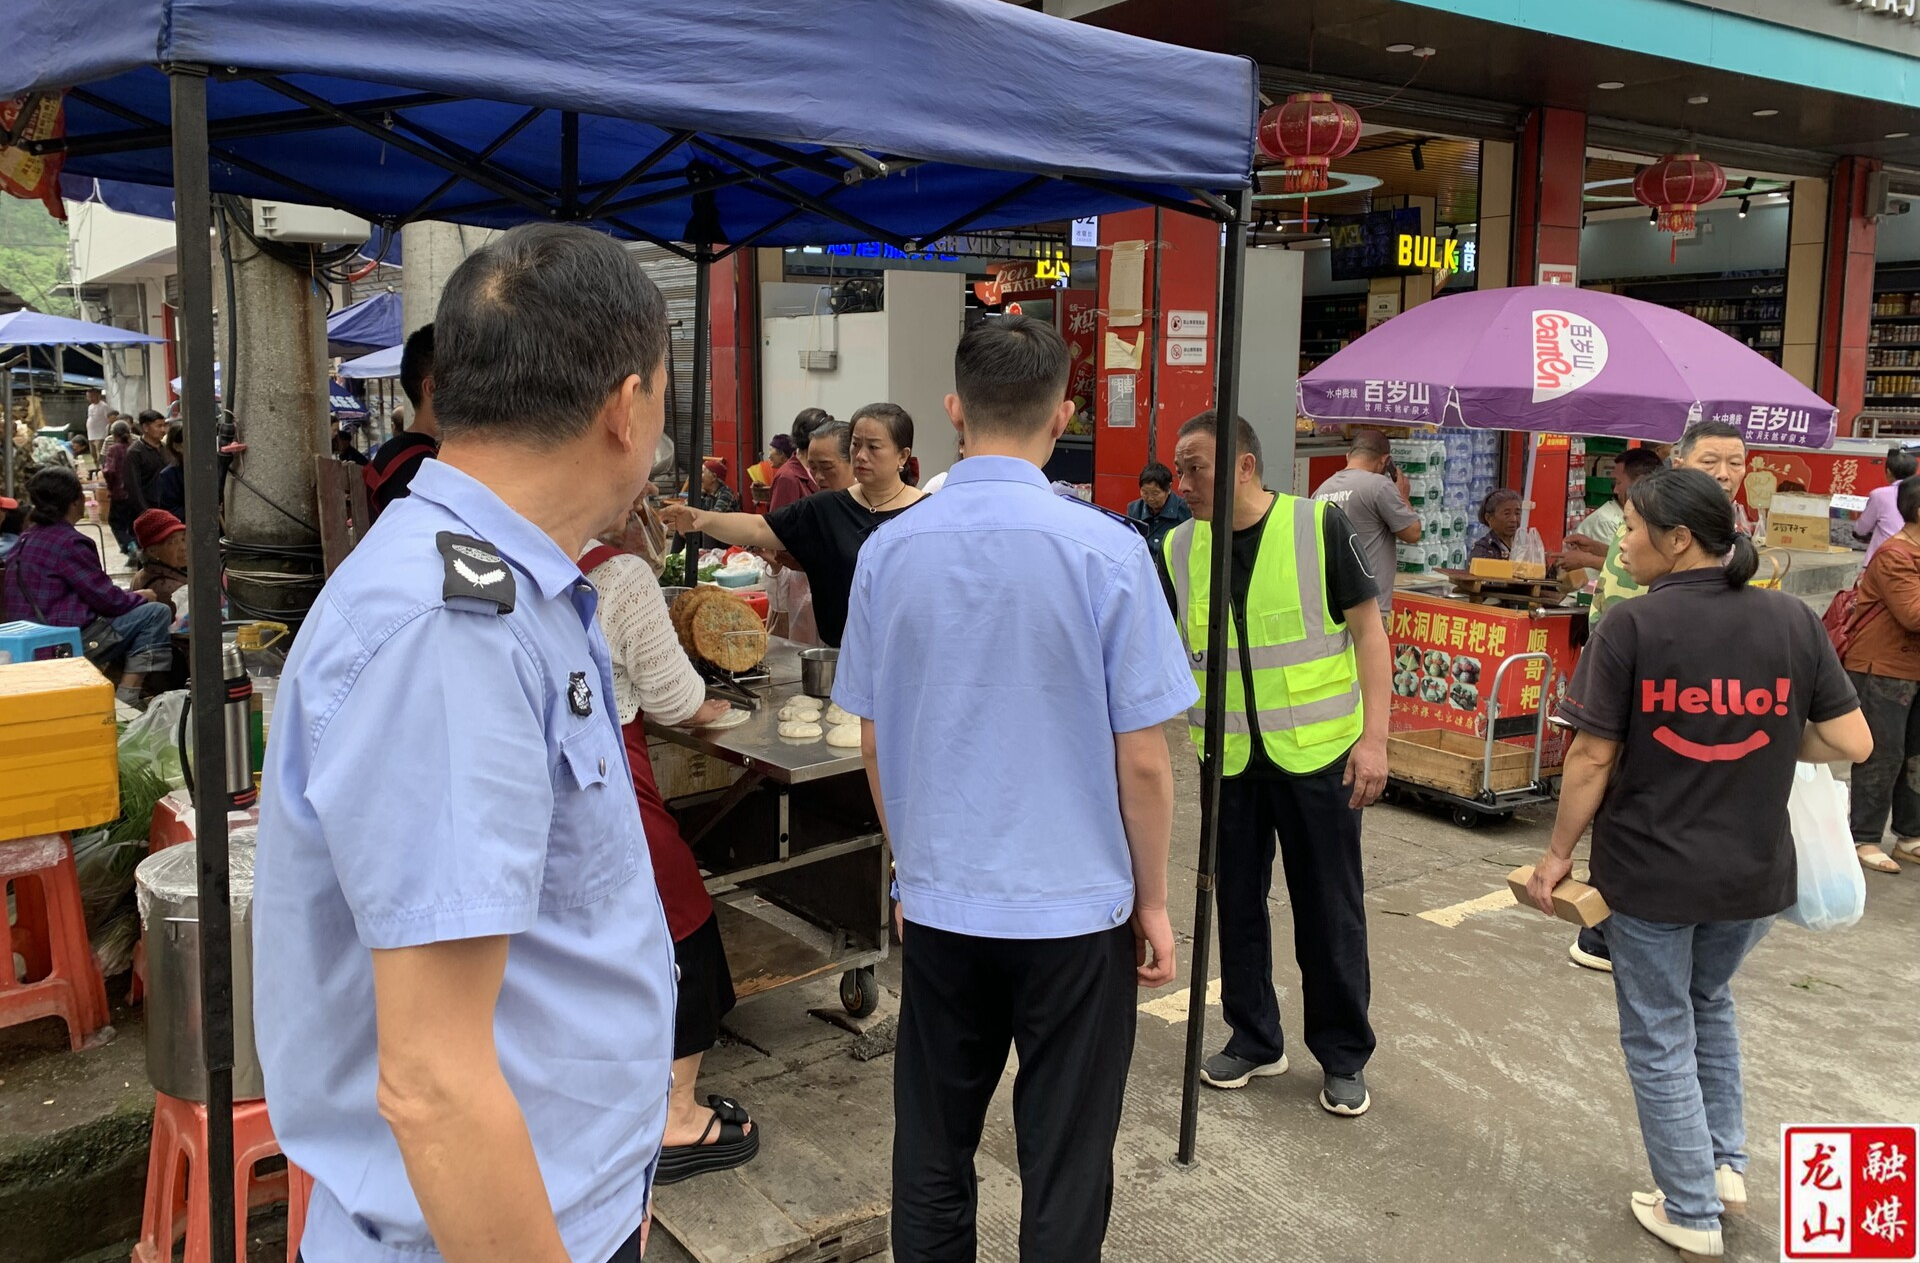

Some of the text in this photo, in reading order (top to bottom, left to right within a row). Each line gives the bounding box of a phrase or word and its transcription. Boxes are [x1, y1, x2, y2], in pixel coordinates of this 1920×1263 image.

[1398, 233, 1458, 269] BULK
[1570, 325, 1595, 370] 百岁山
[1326, 380, 1430, 404] 水中贵族 百岁山
[1364, 403, 1430, 415] 饮用天然矿泉水
[1712, 405, 1810, 433] 水中贵族 百岁山
[1841, 459, 1858, 495] 须尽
[1641, 677, 1791, 716] Hello!
